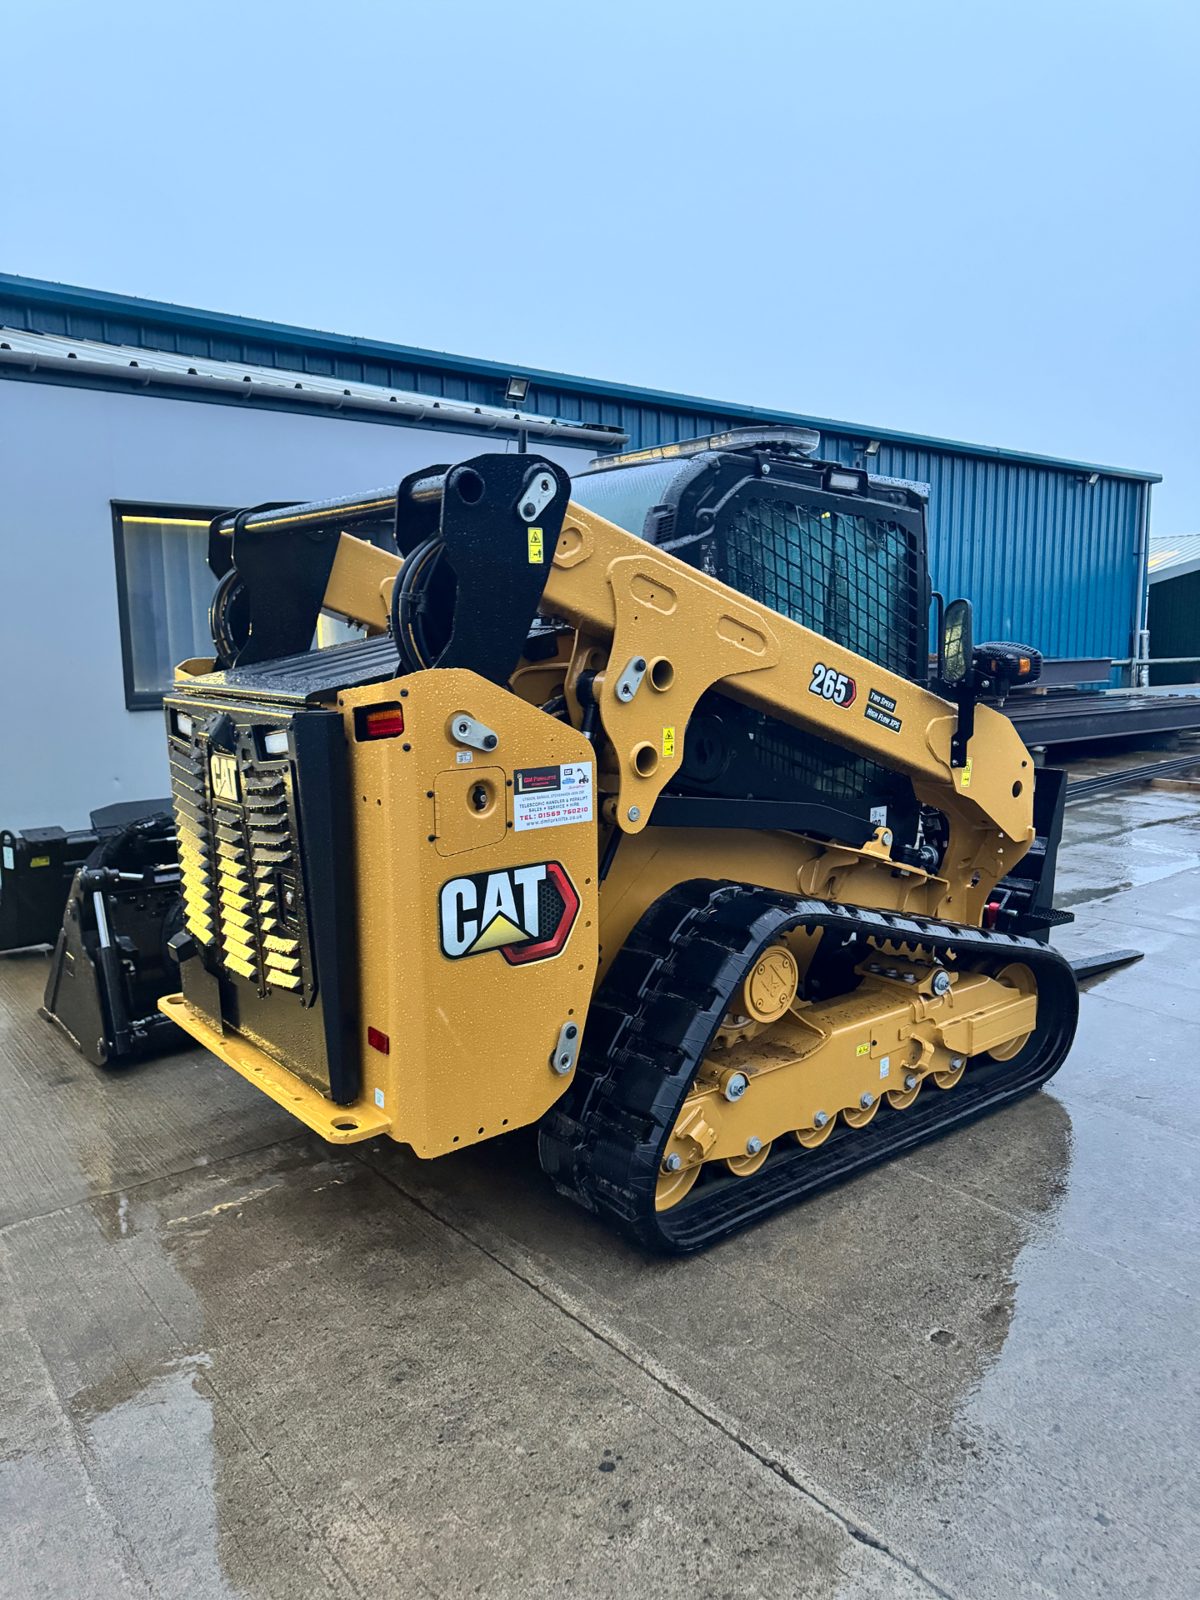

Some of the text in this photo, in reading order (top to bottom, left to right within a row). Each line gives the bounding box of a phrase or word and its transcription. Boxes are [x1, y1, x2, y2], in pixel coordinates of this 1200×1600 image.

[809, 663, 849, 704] 265
[211, 754, 238, 801] CAT
[519, 801, 545, 809] TELESCOPIC
[537, 810, 561, 819] 01569
[563, 806, 588, 815] 760210
[441, 864, 547, 957] CAT
